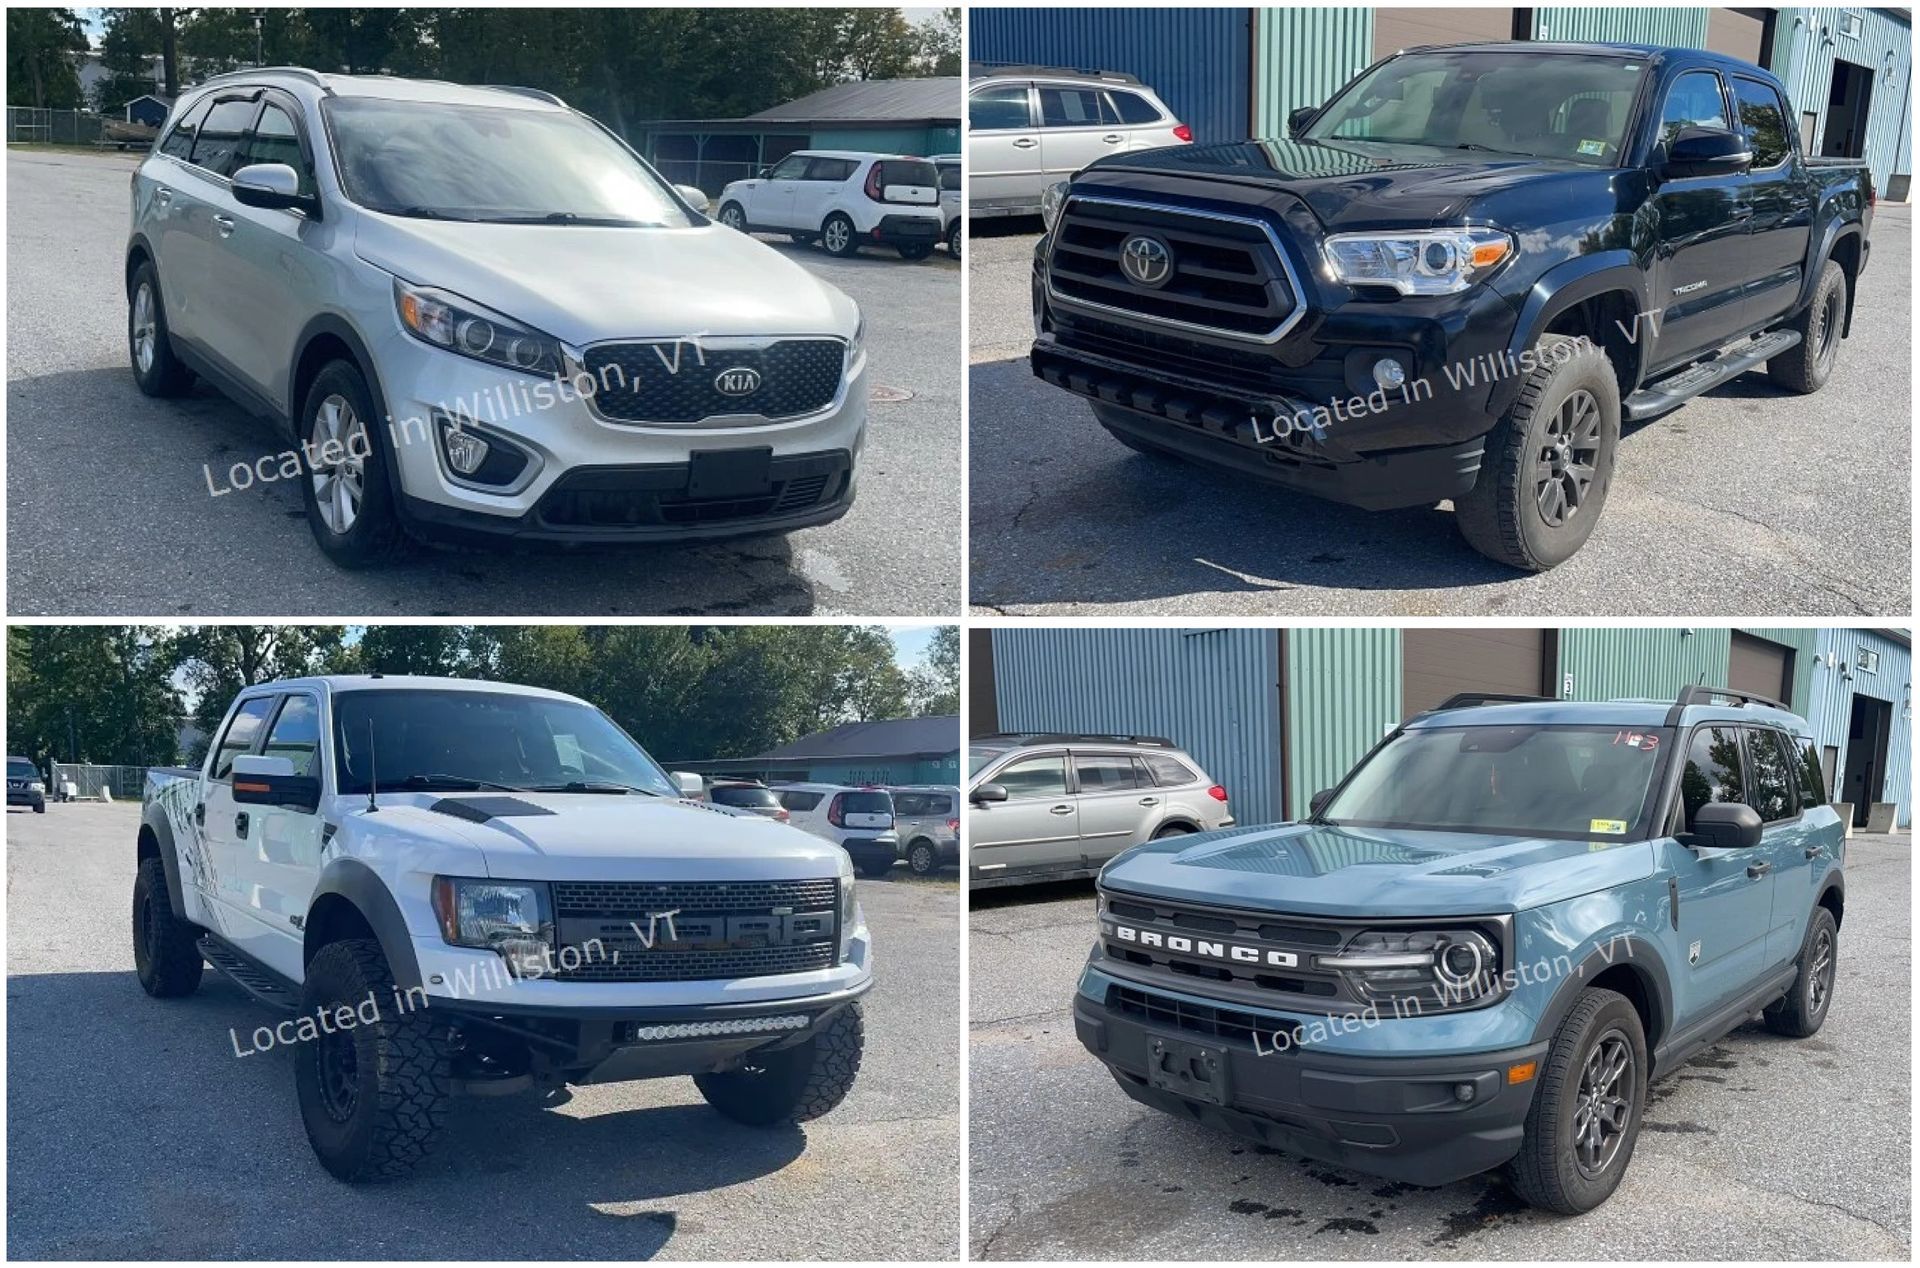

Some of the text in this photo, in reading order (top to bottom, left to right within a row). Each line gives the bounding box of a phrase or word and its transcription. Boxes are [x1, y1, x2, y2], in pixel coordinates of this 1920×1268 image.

[1672, 280, 1708, 295] TACOMA
[724, 374, 754, 390] KIA
[1117, 926, 1298, 968] BRONCO
